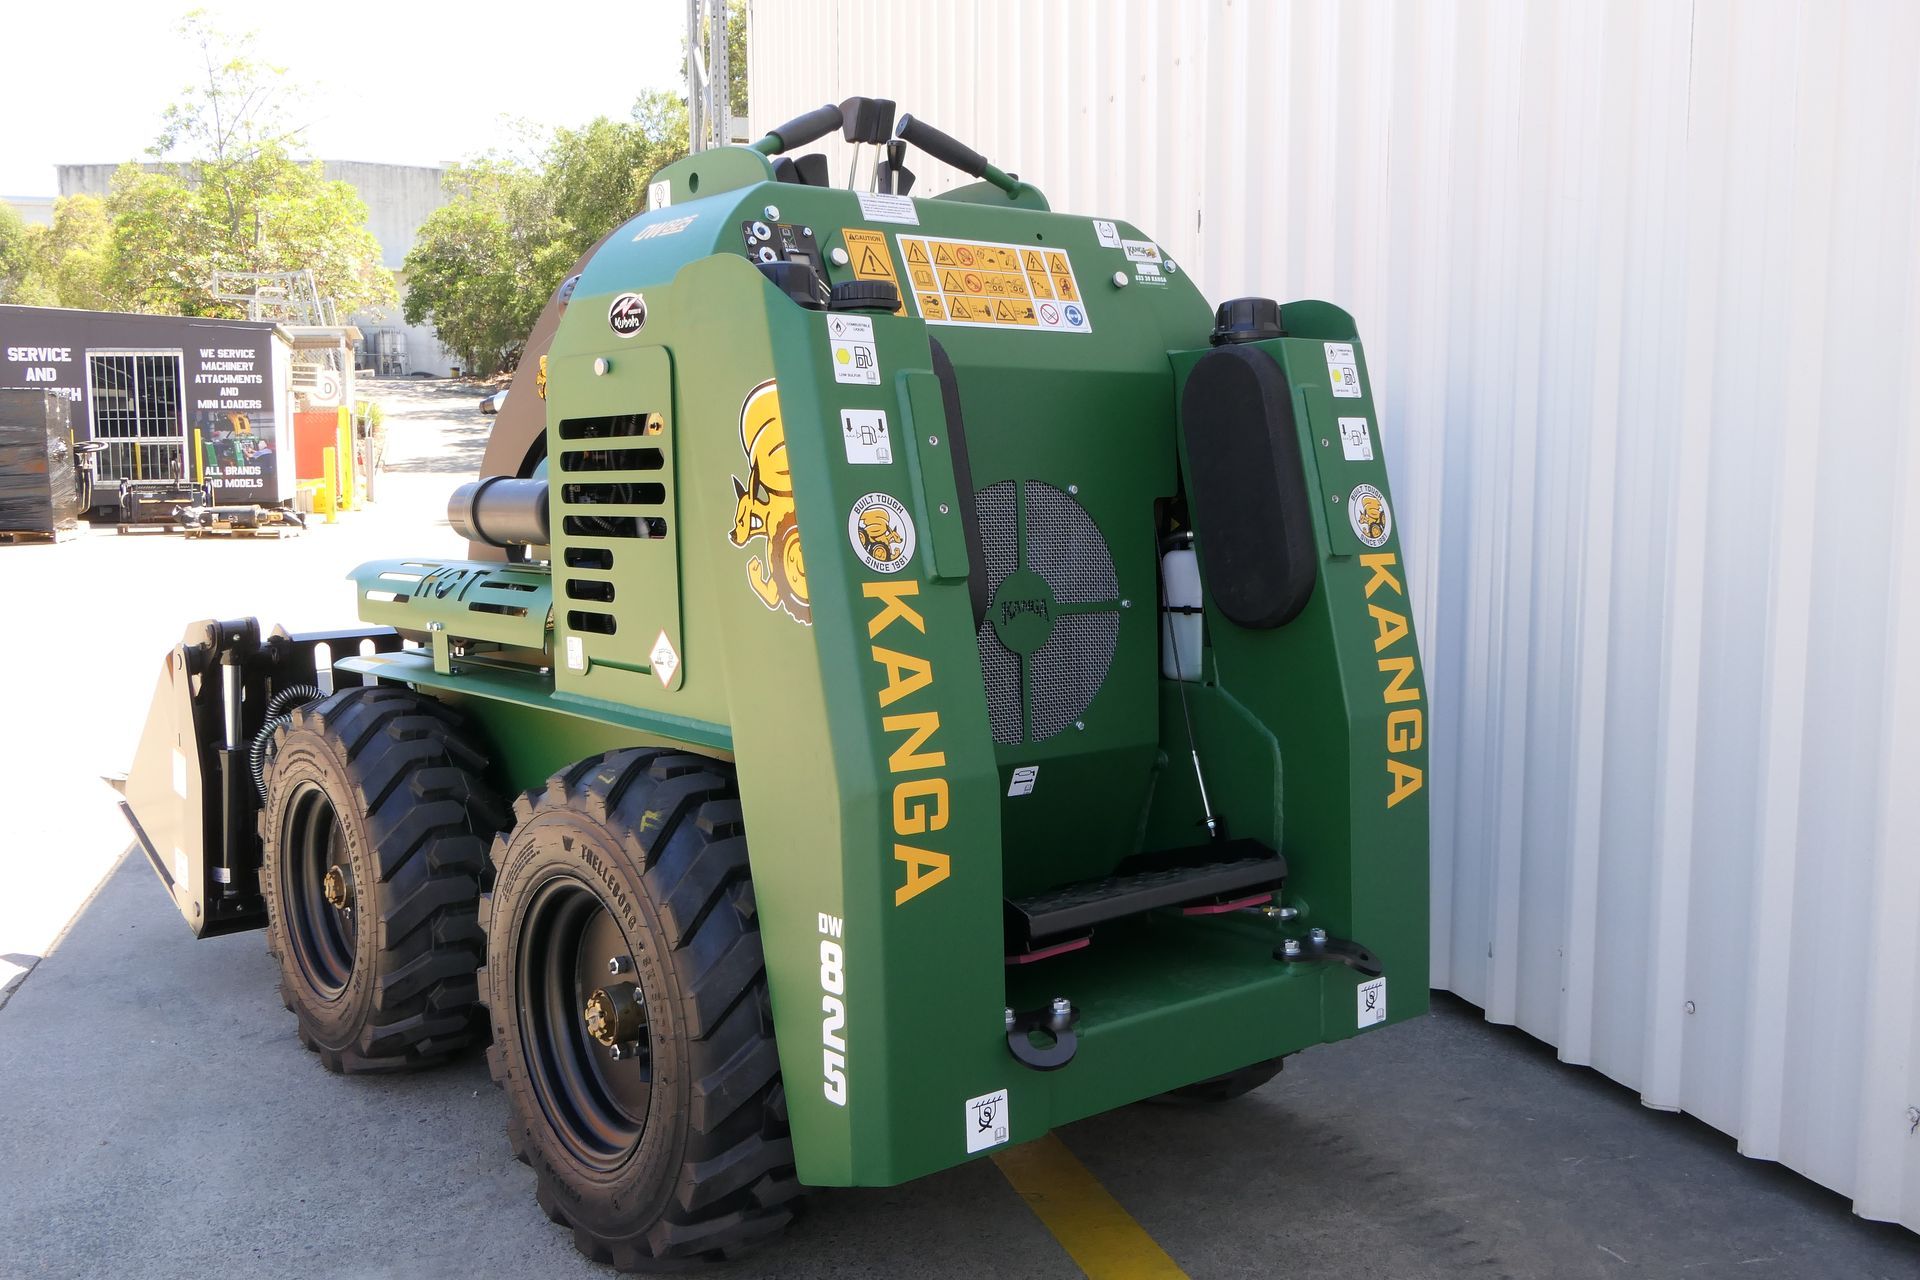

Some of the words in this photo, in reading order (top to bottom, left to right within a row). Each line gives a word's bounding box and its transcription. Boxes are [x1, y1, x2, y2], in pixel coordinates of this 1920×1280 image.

[854, 234, 882, 242] CAUTION
[614, 315, 640, 329] Kubota
[7, 347, 72, 362] SERVICE
[200, 348, 215, 358] WE
[217, 349, 256, 359] SERVICE
[201, 362, 254, 371] MACHINERY
[26, 367, 57, 382] AND
[195, 374, 263, 384] ATTACHMENTS
[220, 387, 239, 396] AND
[197, 400, 218, 409] MINI
[220, 400, 262, 409] LOADERS
[205, 466, 223, 476] ALL
[225, 466, 261, 476] BRANDS
[211, 479, 223, 488] ND
[225, 479, 264, 488] MODELS
[1350, 485, 1363, 501] BUILT
[1364, 485, 1383, 501] TOUGH
[854, 495, 874, 515] BUILT
[876, 494, 904, 514] TOUGH
[1360, 533, 1377, 547] SINCE
[865, 556, 890, 572] SINCE
[1001, 599, 1049, 626] KANGA
[1359, 552, 1422, 809] KANGA
[862, 580, 951, 907] KANGA
[580, 843, 637, 931] TRELLEBORG
[818, 911, 843, 938] DW
[820, 939, 847, 1107] 825
